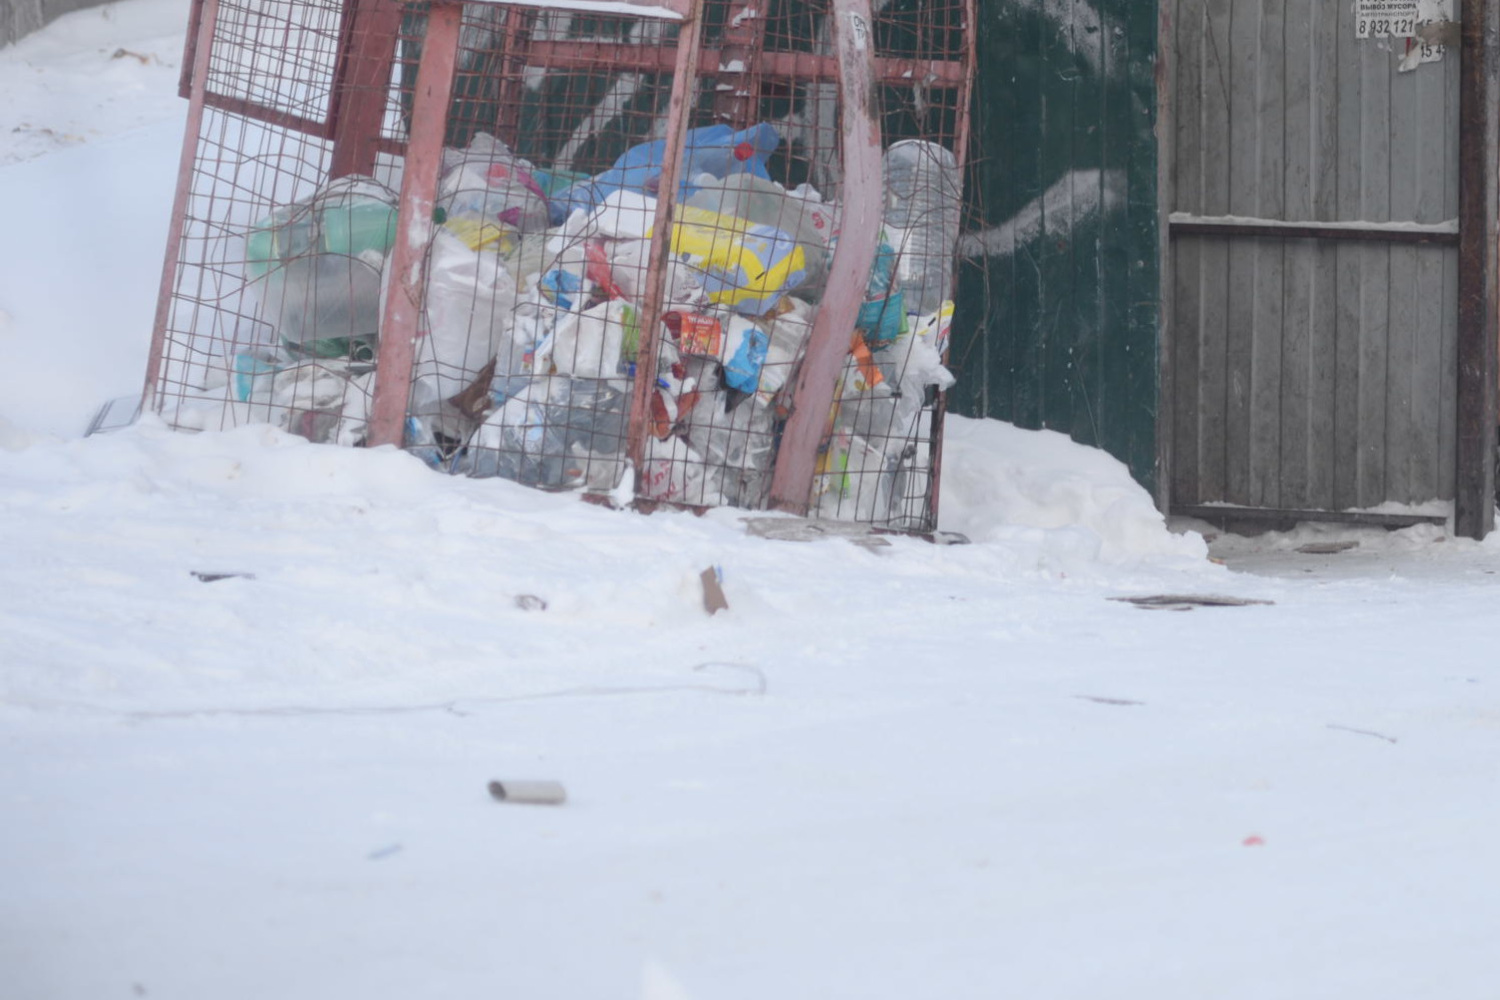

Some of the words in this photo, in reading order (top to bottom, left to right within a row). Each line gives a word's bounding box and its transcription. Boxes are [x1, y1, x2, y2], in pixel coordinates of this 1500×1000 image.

[1387, 2, 1417, 10] МУСОРА
[1359, 20, 1367, 34] 8
[1370, 19, 1390, 34] 932
[1393, 20, 1414, 34] 121
